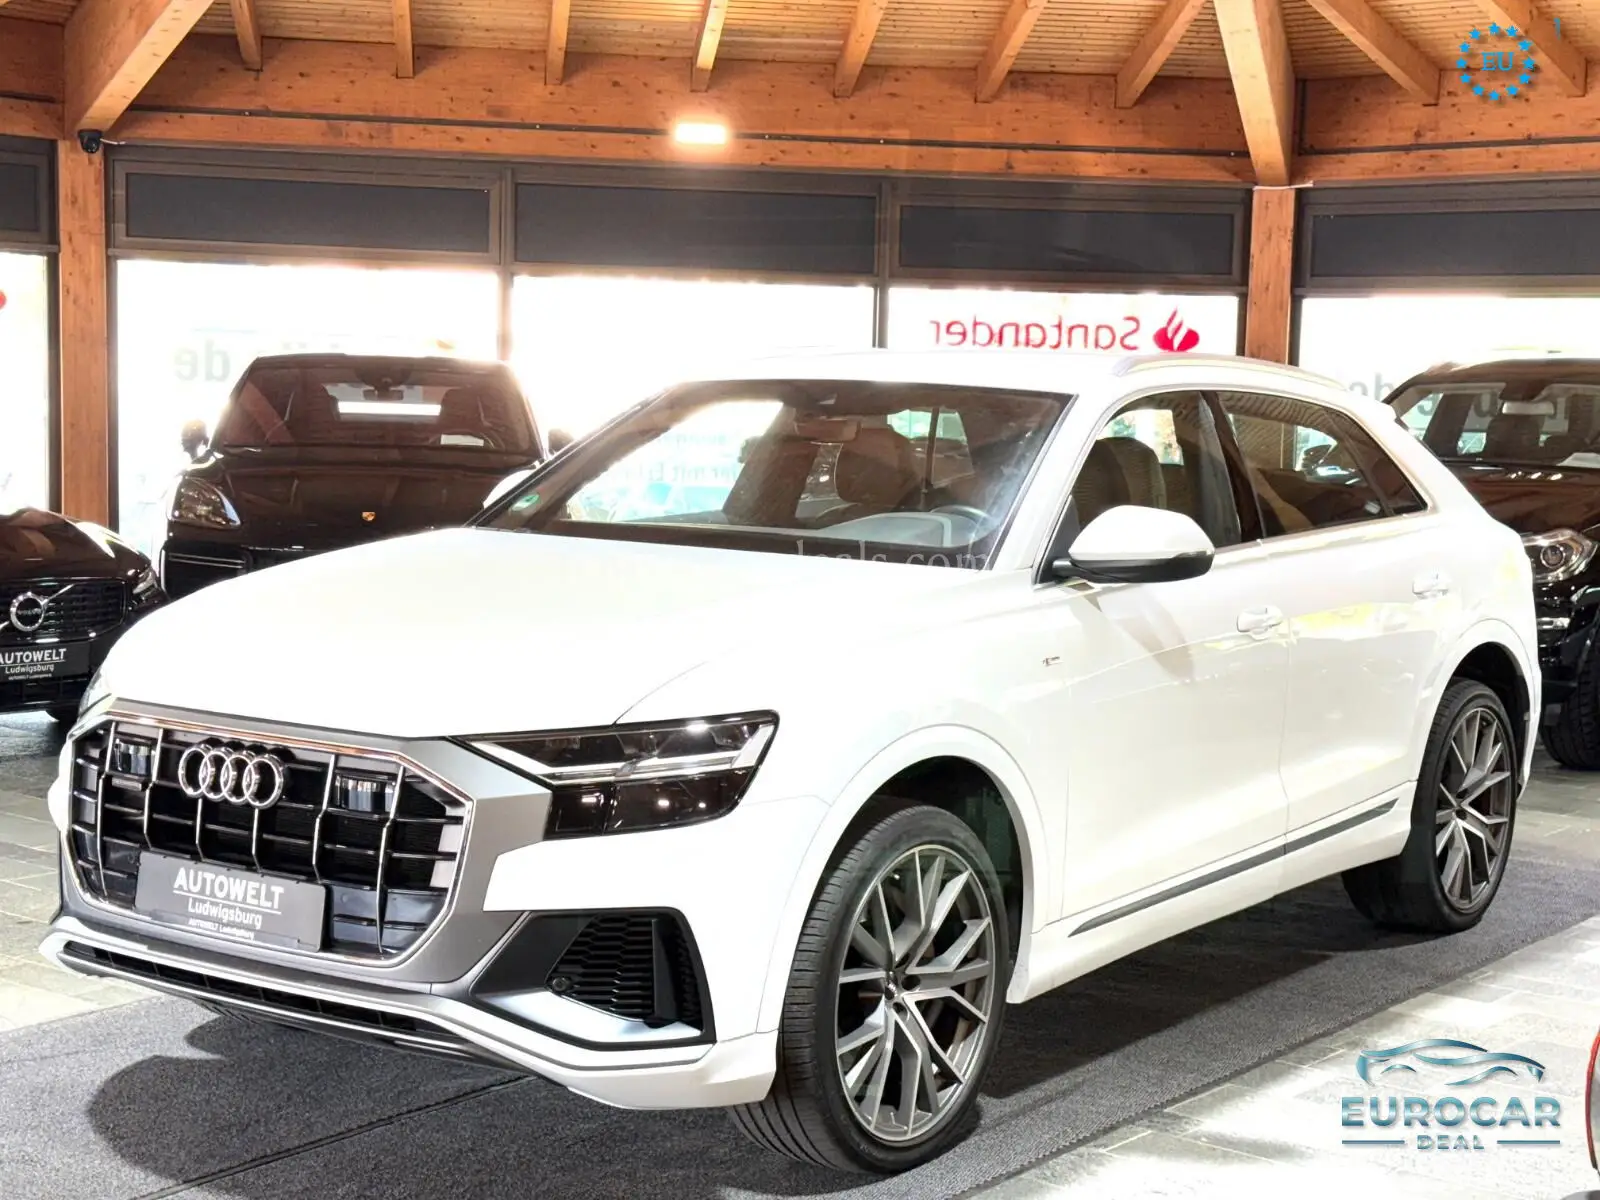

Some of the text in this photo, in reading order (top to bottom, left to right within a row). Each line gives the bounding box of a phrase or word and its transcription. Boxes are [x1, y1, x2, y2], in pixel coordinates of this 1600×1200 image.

[5, 664, 54, 673] Ludwigsburg
[173, 867, 284, 909] AUTOWELT
[188, 897, 262, 930] Ludwigsburg
